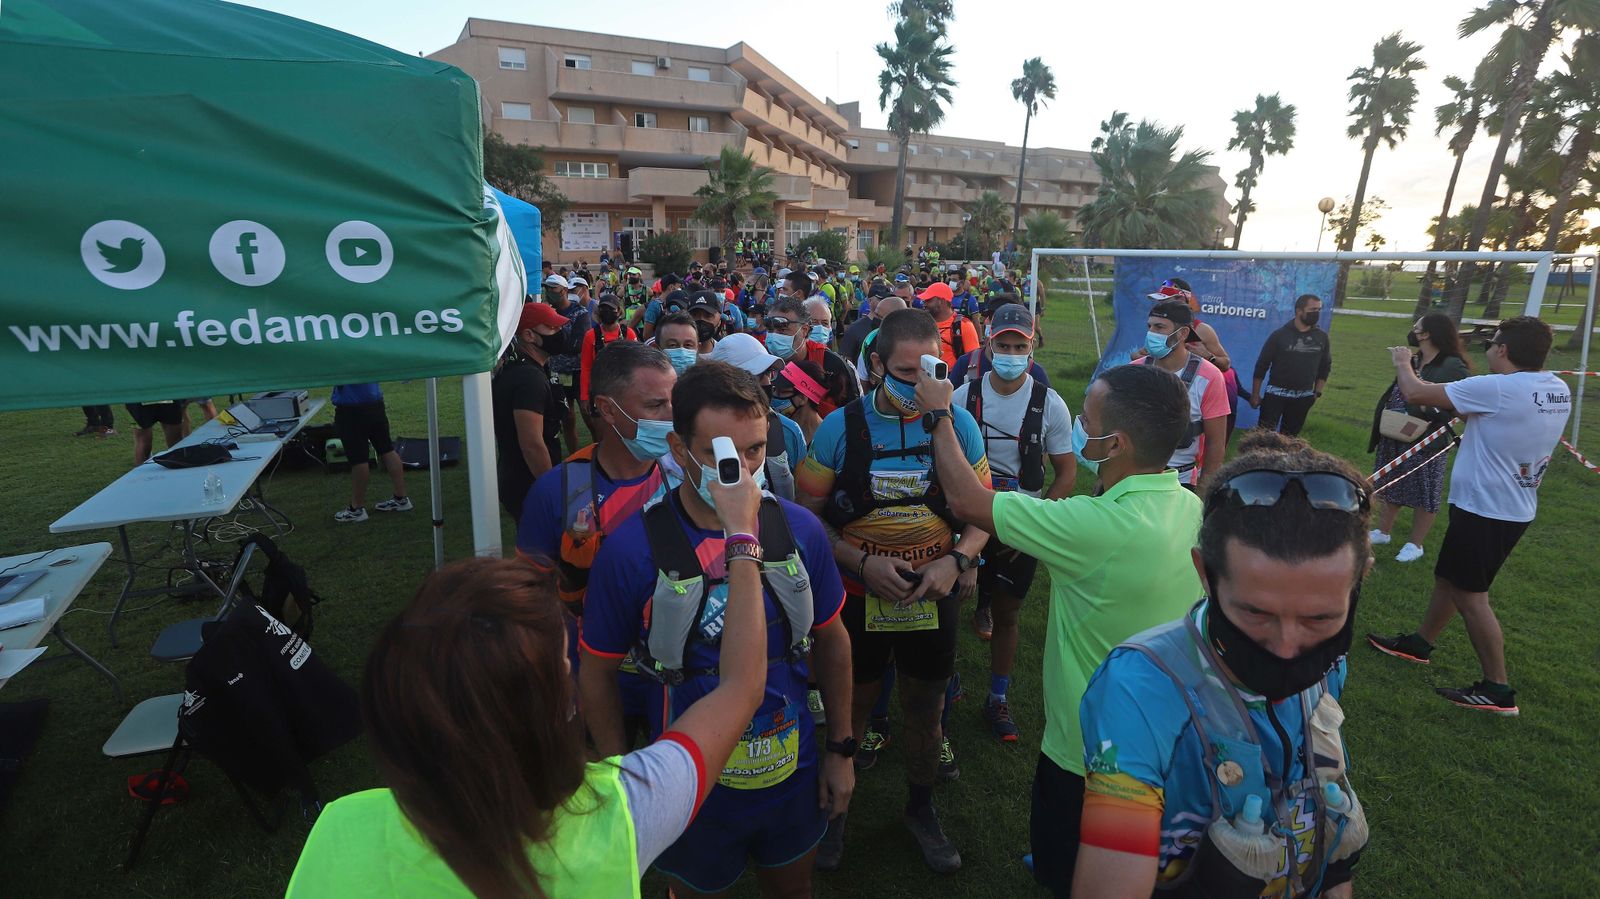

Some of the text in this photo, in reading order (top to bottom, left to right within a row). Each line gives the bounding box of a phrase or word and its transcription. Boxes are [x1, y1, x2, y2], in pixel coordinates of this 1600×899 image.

[1201, 302, 1267, 319] carbonera
[9, 308, 464, 353] www.fedamon.es
[875, 476, 921, 490] TRAIL
[746, 738, 772, 758] 173
[722, 763, 775, 775] arbonera
